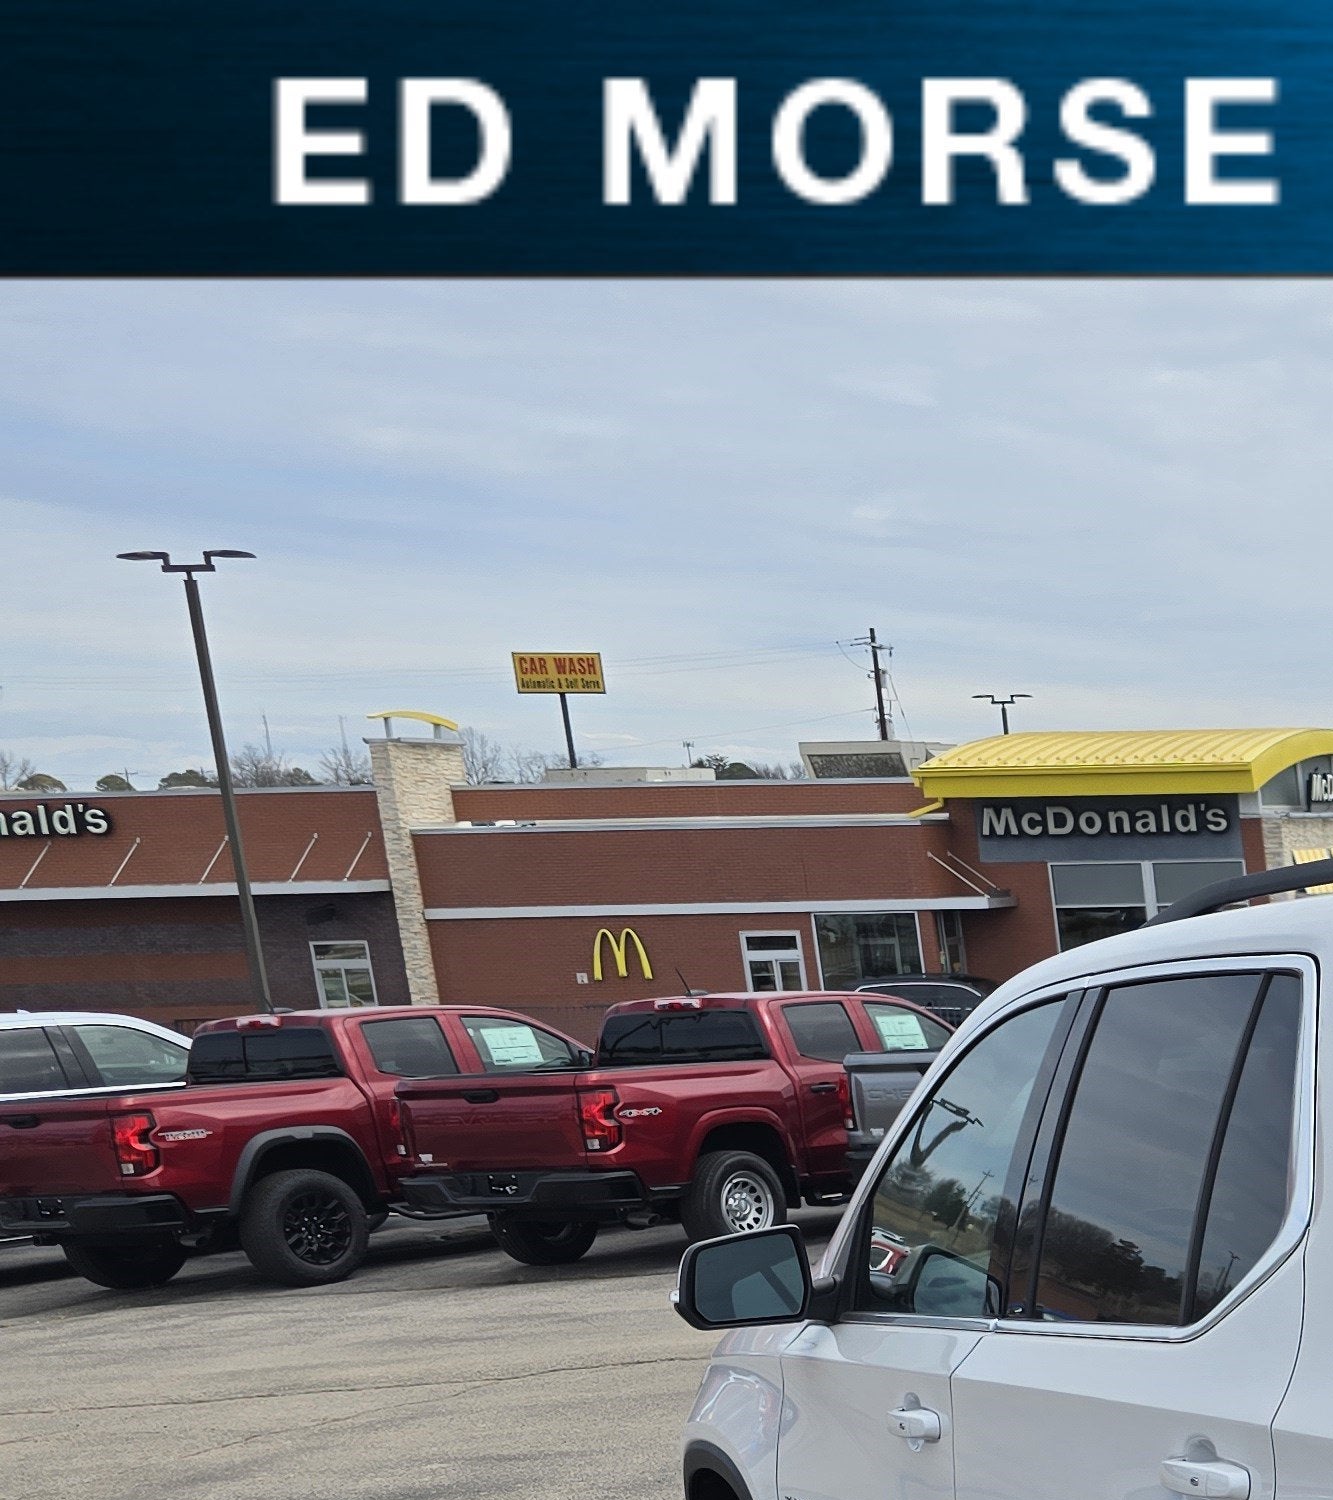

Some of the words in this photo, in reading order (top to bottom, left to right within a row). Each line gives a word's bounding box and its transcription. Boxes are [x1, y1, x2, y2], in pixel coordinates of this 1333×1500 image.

[518, 656, 548, 675] CAR
[553, 656, 597, 675] WASH
[981, 803, 1229, 836] McDonald's
